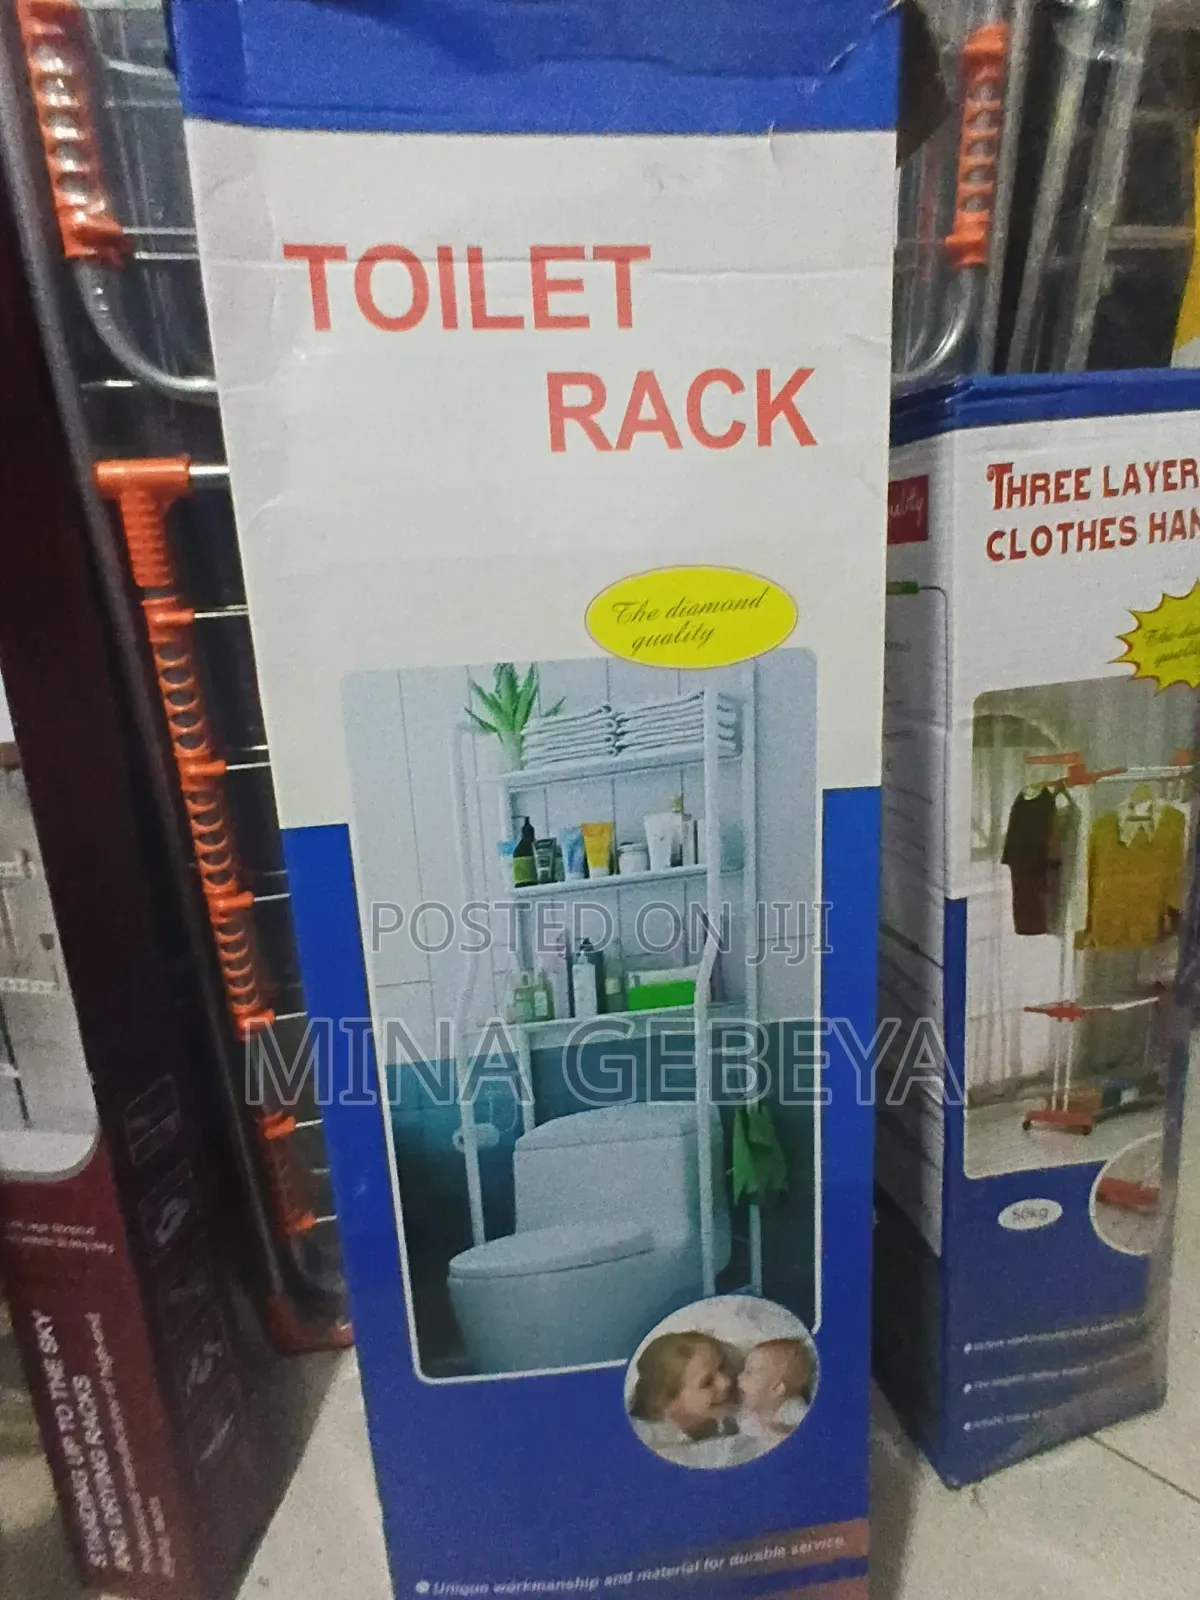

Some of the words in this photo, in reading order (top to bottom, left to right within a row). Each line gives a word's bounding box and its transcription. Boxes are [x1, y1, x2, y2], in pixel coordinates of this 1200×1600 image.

[283, 244, 651, 332] TOILET
[546, 368, 818, 453] RACK
[986, 462, 1092, 511] THREE
[985, 515, 1138, 562] CLOTHES
[612, 598, 660, 626] The
[665, 586, 770, 621] diamond
[631, 620, 716, 657] quality
[31, 1309, 59, 1355] SKY
[492, 1575, 600, 1595] workmanship
[603, 1570, 634, 1587] and
[636, 1560, 699, 1582] material
[703, 1556, 725, 1572] for
[729, 1546, 786, 1567] durable
